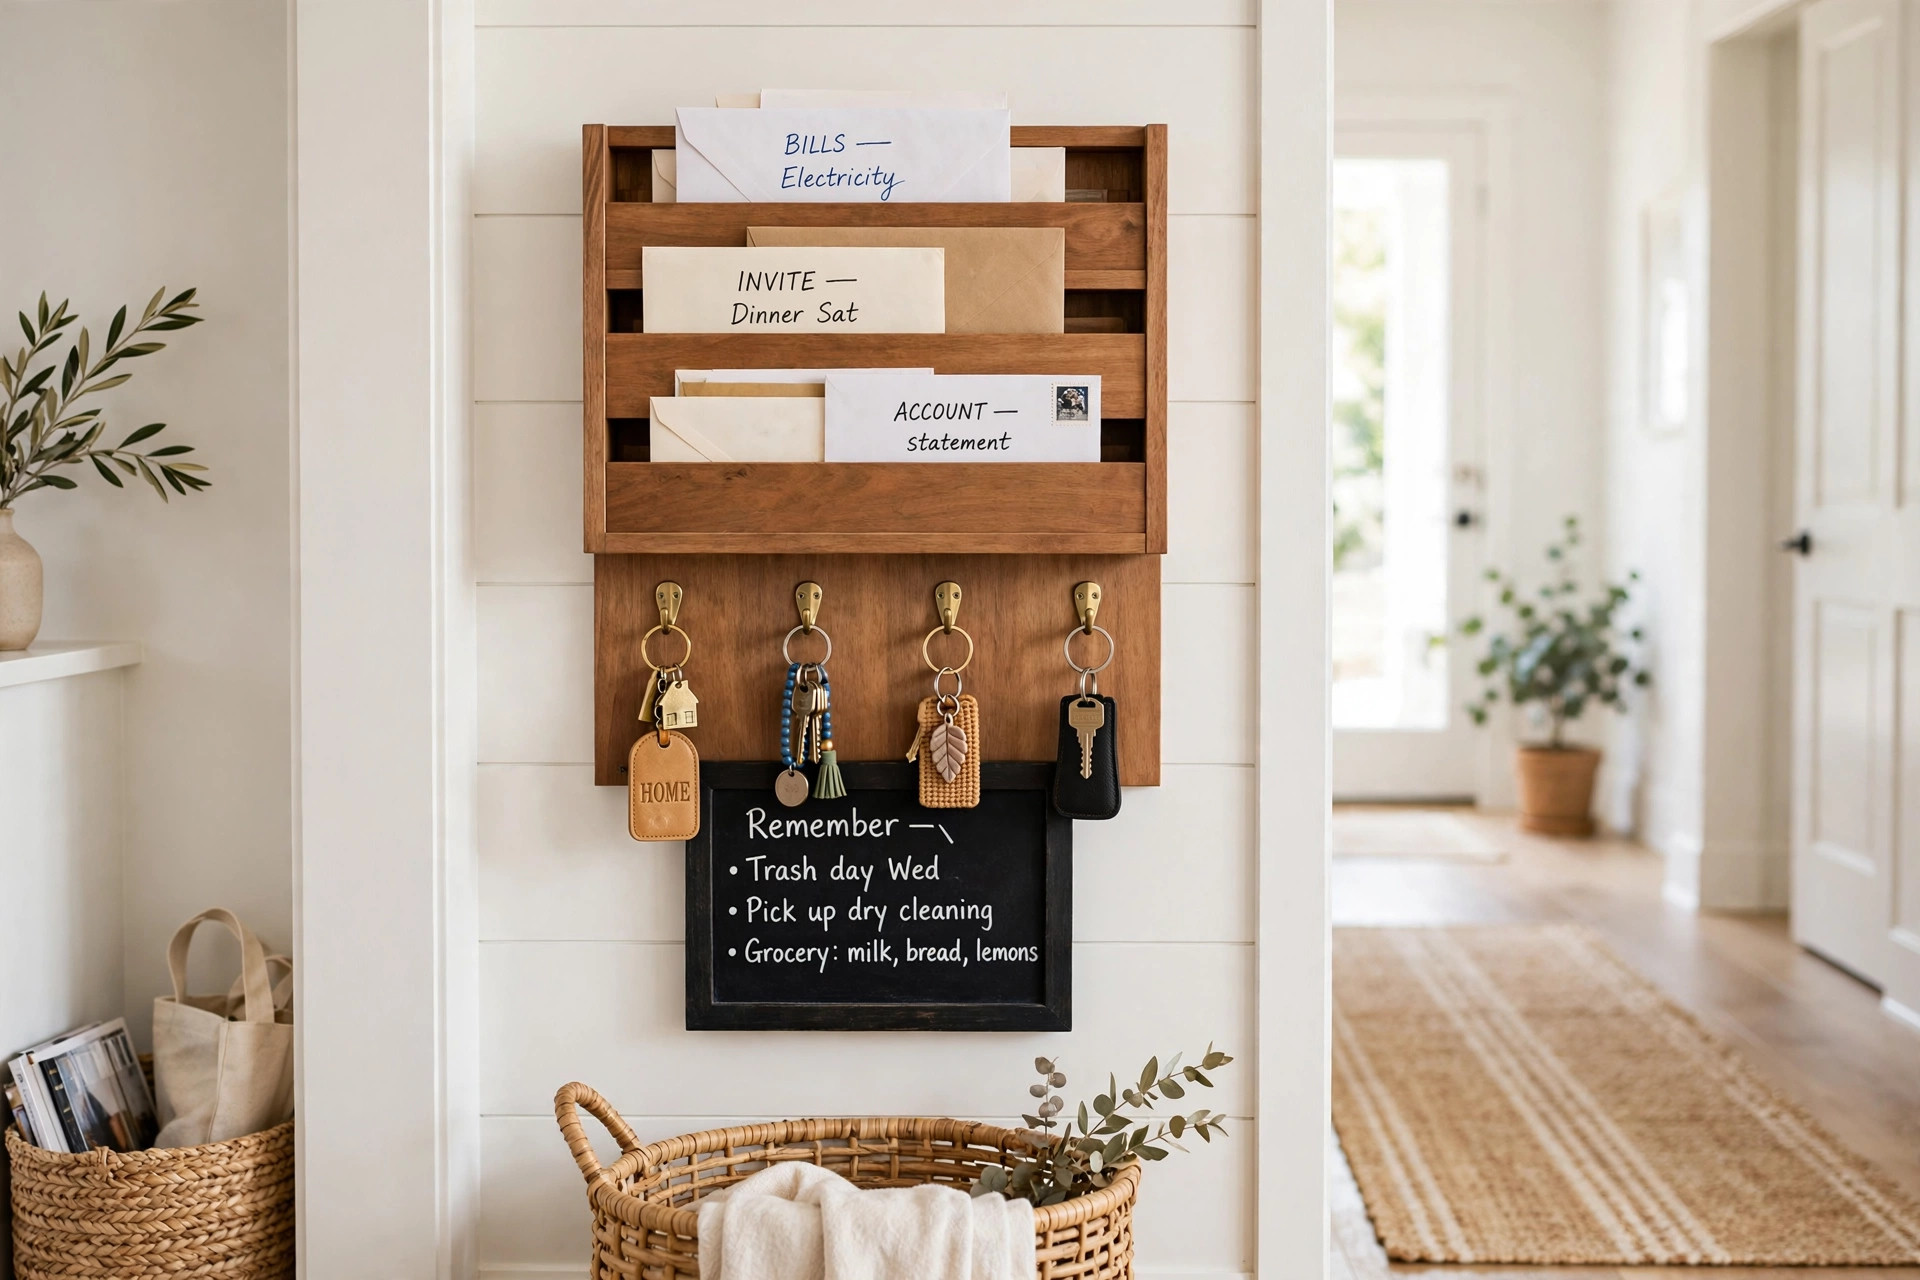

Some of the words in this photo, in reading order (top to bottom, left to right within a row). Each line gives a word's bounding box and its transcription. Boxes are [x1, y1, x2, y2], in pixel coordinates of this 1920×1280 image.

[784, 132, 846, 156] BILLS
[780, 165, 905, 201] Electricity
[737, 270, 817, 292] INVITE
[730, 302, 805, 326] Dinner
[816, 301, 860, 324] Sat
[893, 400, 988, 422] ACCOUNT
[906, 431, 1013, 452] statement
[640, 781, 690, 803] HOME
[745, 807, 900, 840] Remember
[745, 854, 817, 882] Trash
[830, 854, 874, 893] day
[887, 854, 940, 881] Wed
[746, 895, 797, 923] Pick
[808, 905, 836, 932] up
[848, 895, 888, 933] dry
[899, 895, 993, 932] cleaning
[744, 937, 838, 974] Grocery:
[847, 938, 899, 968] milk,
[906, 937, 969, 968] bread,
[976, 937, 1039, 963] lemons
